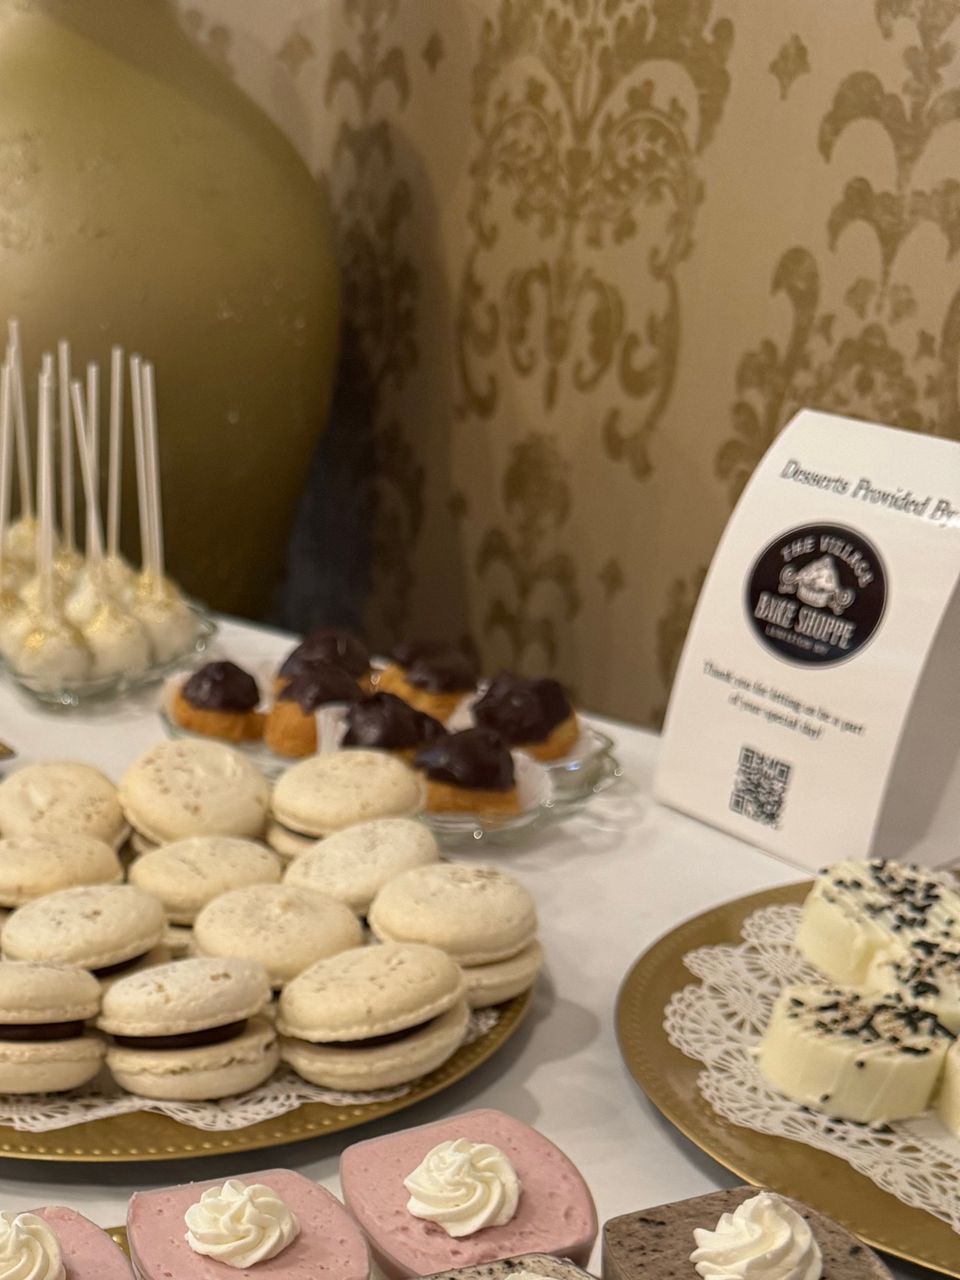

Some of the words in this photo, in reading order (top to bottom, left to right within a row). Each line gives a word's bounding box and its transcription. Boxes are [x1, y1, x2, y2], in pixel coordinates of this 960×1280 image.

[780, 459, 849, 495] Desserts
[851, 477, 930, 516] Provided
[780, 535, 816, 561] THE
[820, 535, 874, 588] VILLAGE
[754, 591, 797, 629] BAKE
[795, 606, 856, 650] SHOPPE
